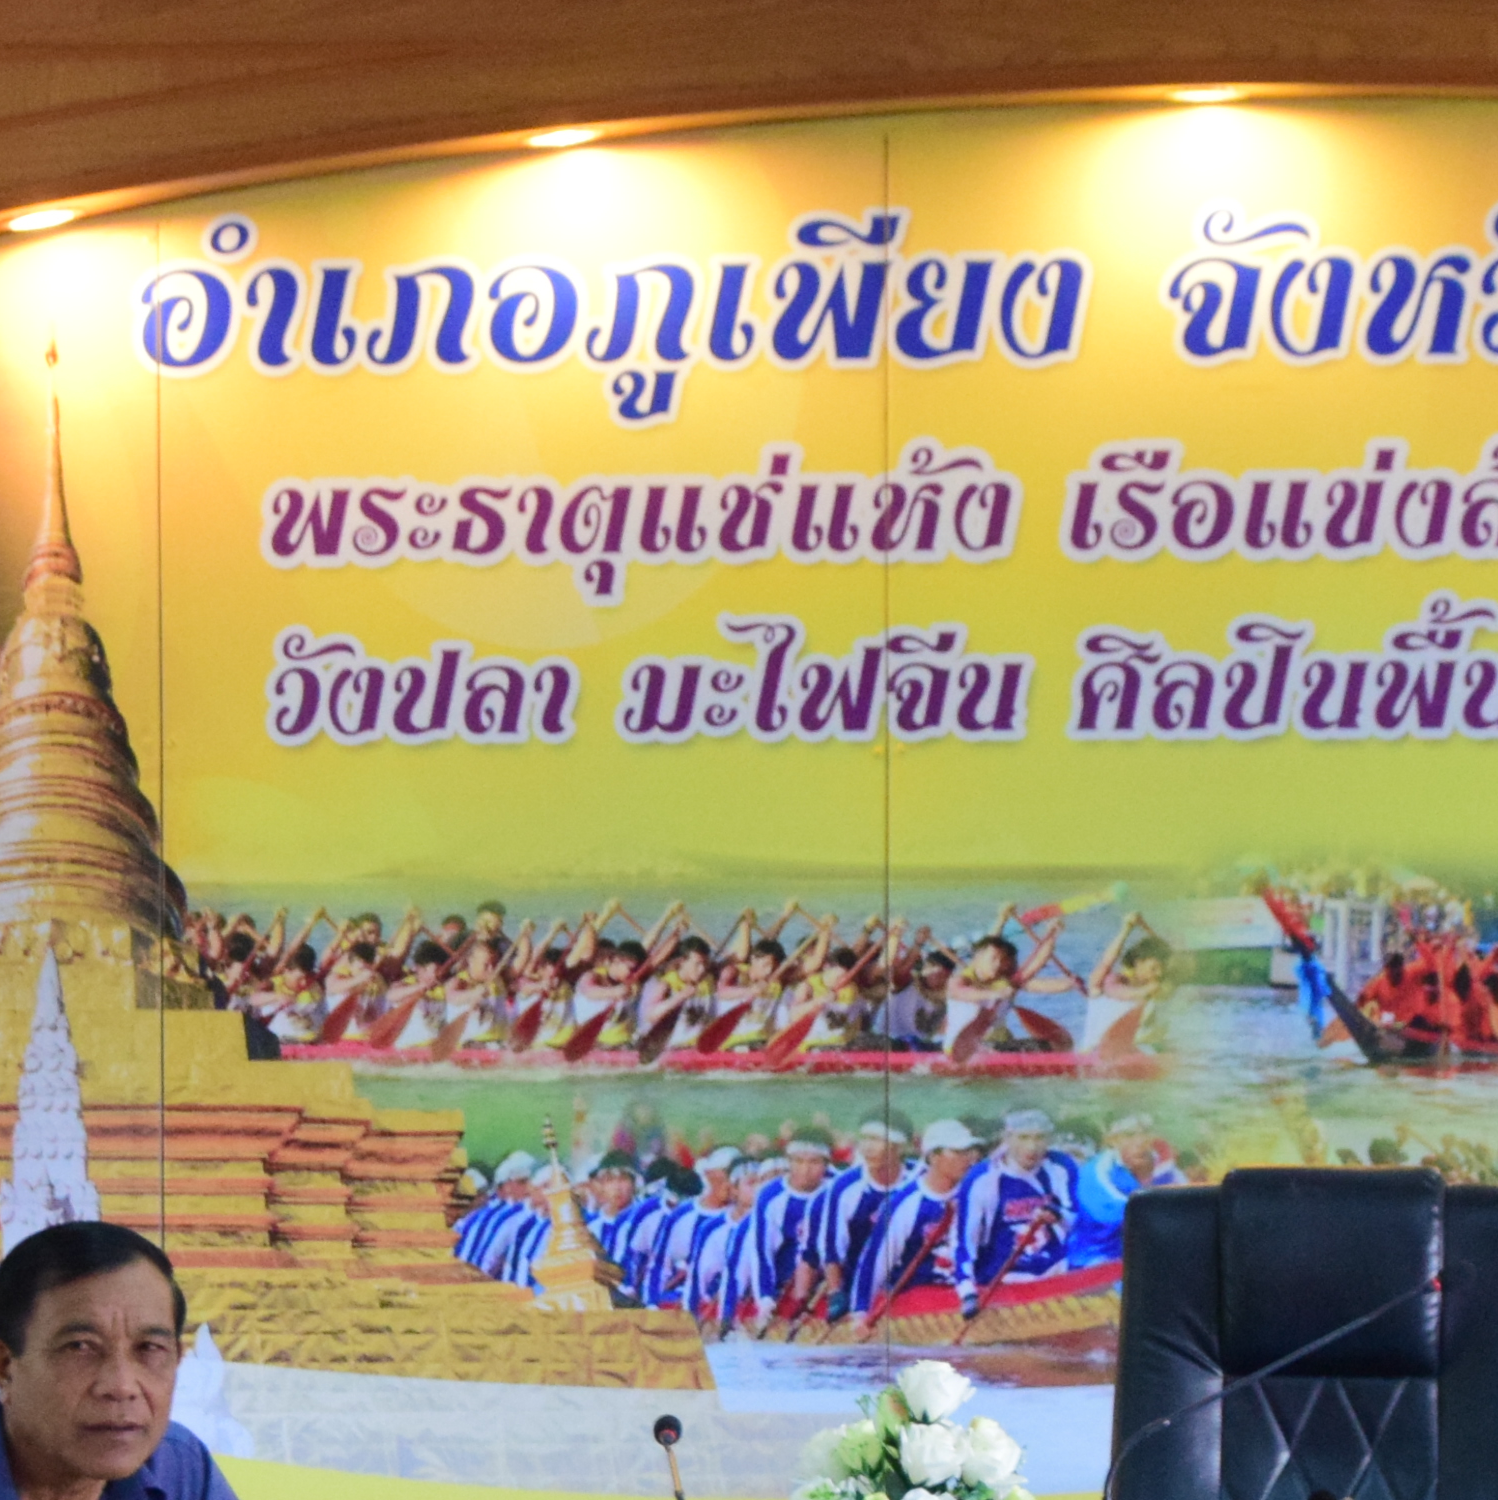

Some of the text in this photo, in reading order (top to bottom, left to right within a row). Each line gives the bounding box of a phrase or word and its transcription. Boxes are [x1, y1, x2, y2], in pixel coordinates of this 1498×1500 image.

[141, 217, 1084, 421] อำเภอภูเพียง
[271, 447, 1012, 596] พระธาตุแช่แห้ง
[273, 636, 571, 736] วังปลา
[629, 624, 1023, 735] มะไฟจีน
